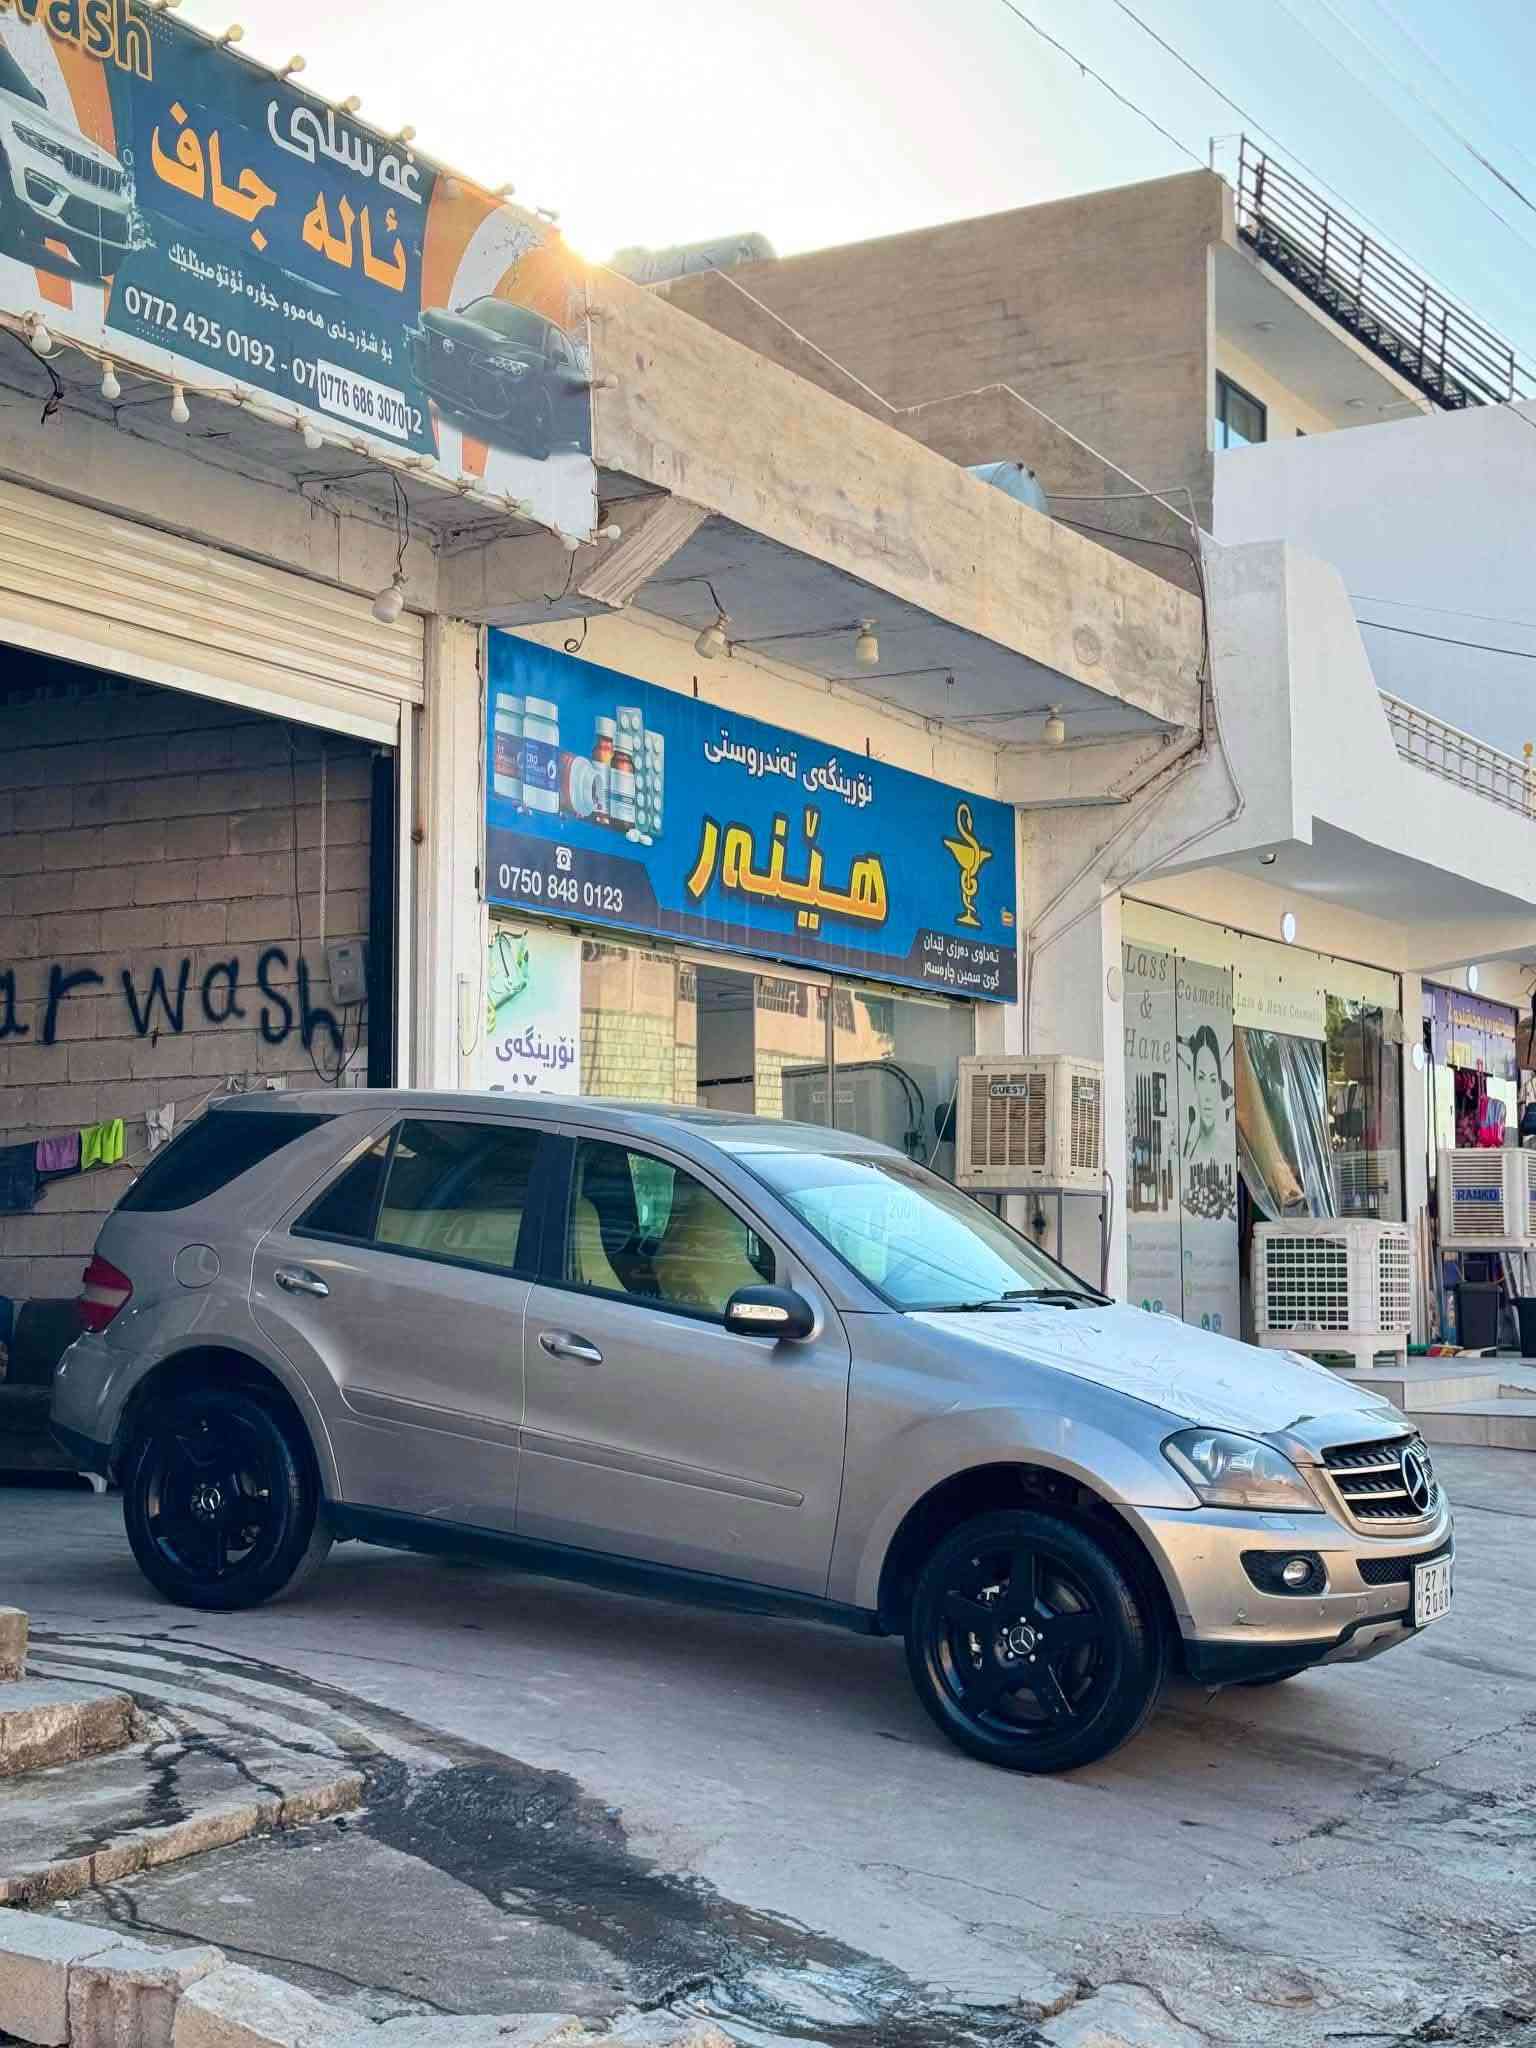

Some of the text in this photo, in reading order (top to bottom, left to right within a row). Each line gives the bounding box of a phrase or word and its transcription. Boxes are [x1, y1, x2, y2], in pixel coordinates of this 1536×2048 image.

[151, 101, 278, 253] جاف
[125, 286, 178, 332] 0772
[183, 311, 222, 349] 425
[226, 329, 276, 373] 0192
[319, 370, 405, 431] 0776 686 3070
[703, 728, 797, 778] تەندروستی
[499, 863, 624, 913] 0750 848 0123
[1125, 944, 1168, 982] Lass
[122, 947, 343, 1075] wash
[1140, 988, 1152, 1021] &
[1176, 977, 1232, 1012] Cosmetic
[1124, 1026, 1172, 1064] Hane
[1425, 1569, 1437, 1593] 27
